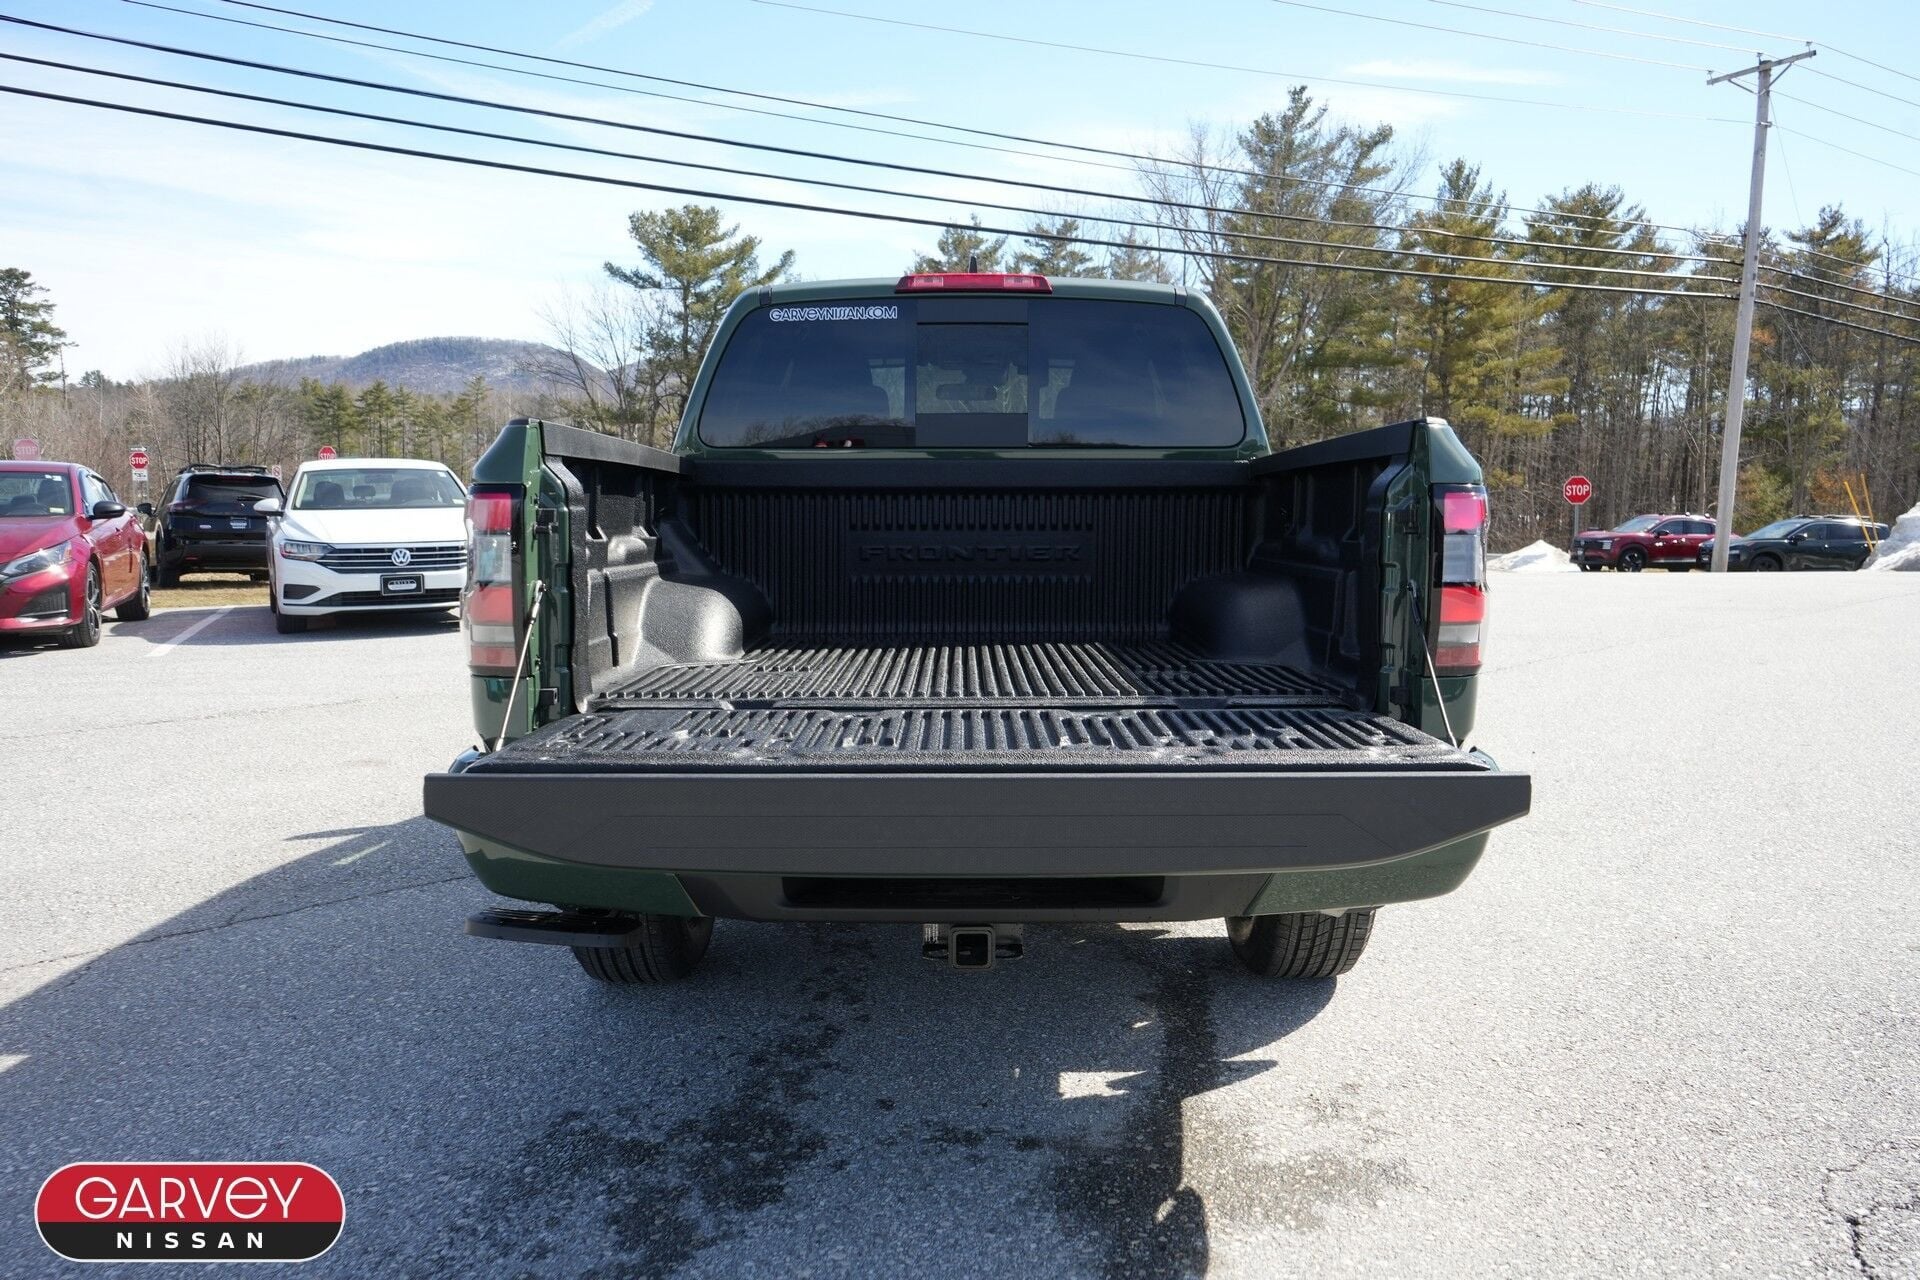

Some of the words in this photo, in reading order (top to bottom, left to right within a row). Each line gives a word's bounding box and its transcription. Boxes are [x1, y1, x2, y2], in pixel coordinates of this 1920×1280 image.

[131, 457, 148, 465] STOP
[1565, 485, 1590, 496] STOP
[860, 545, 1081, 562] FRONTIER
